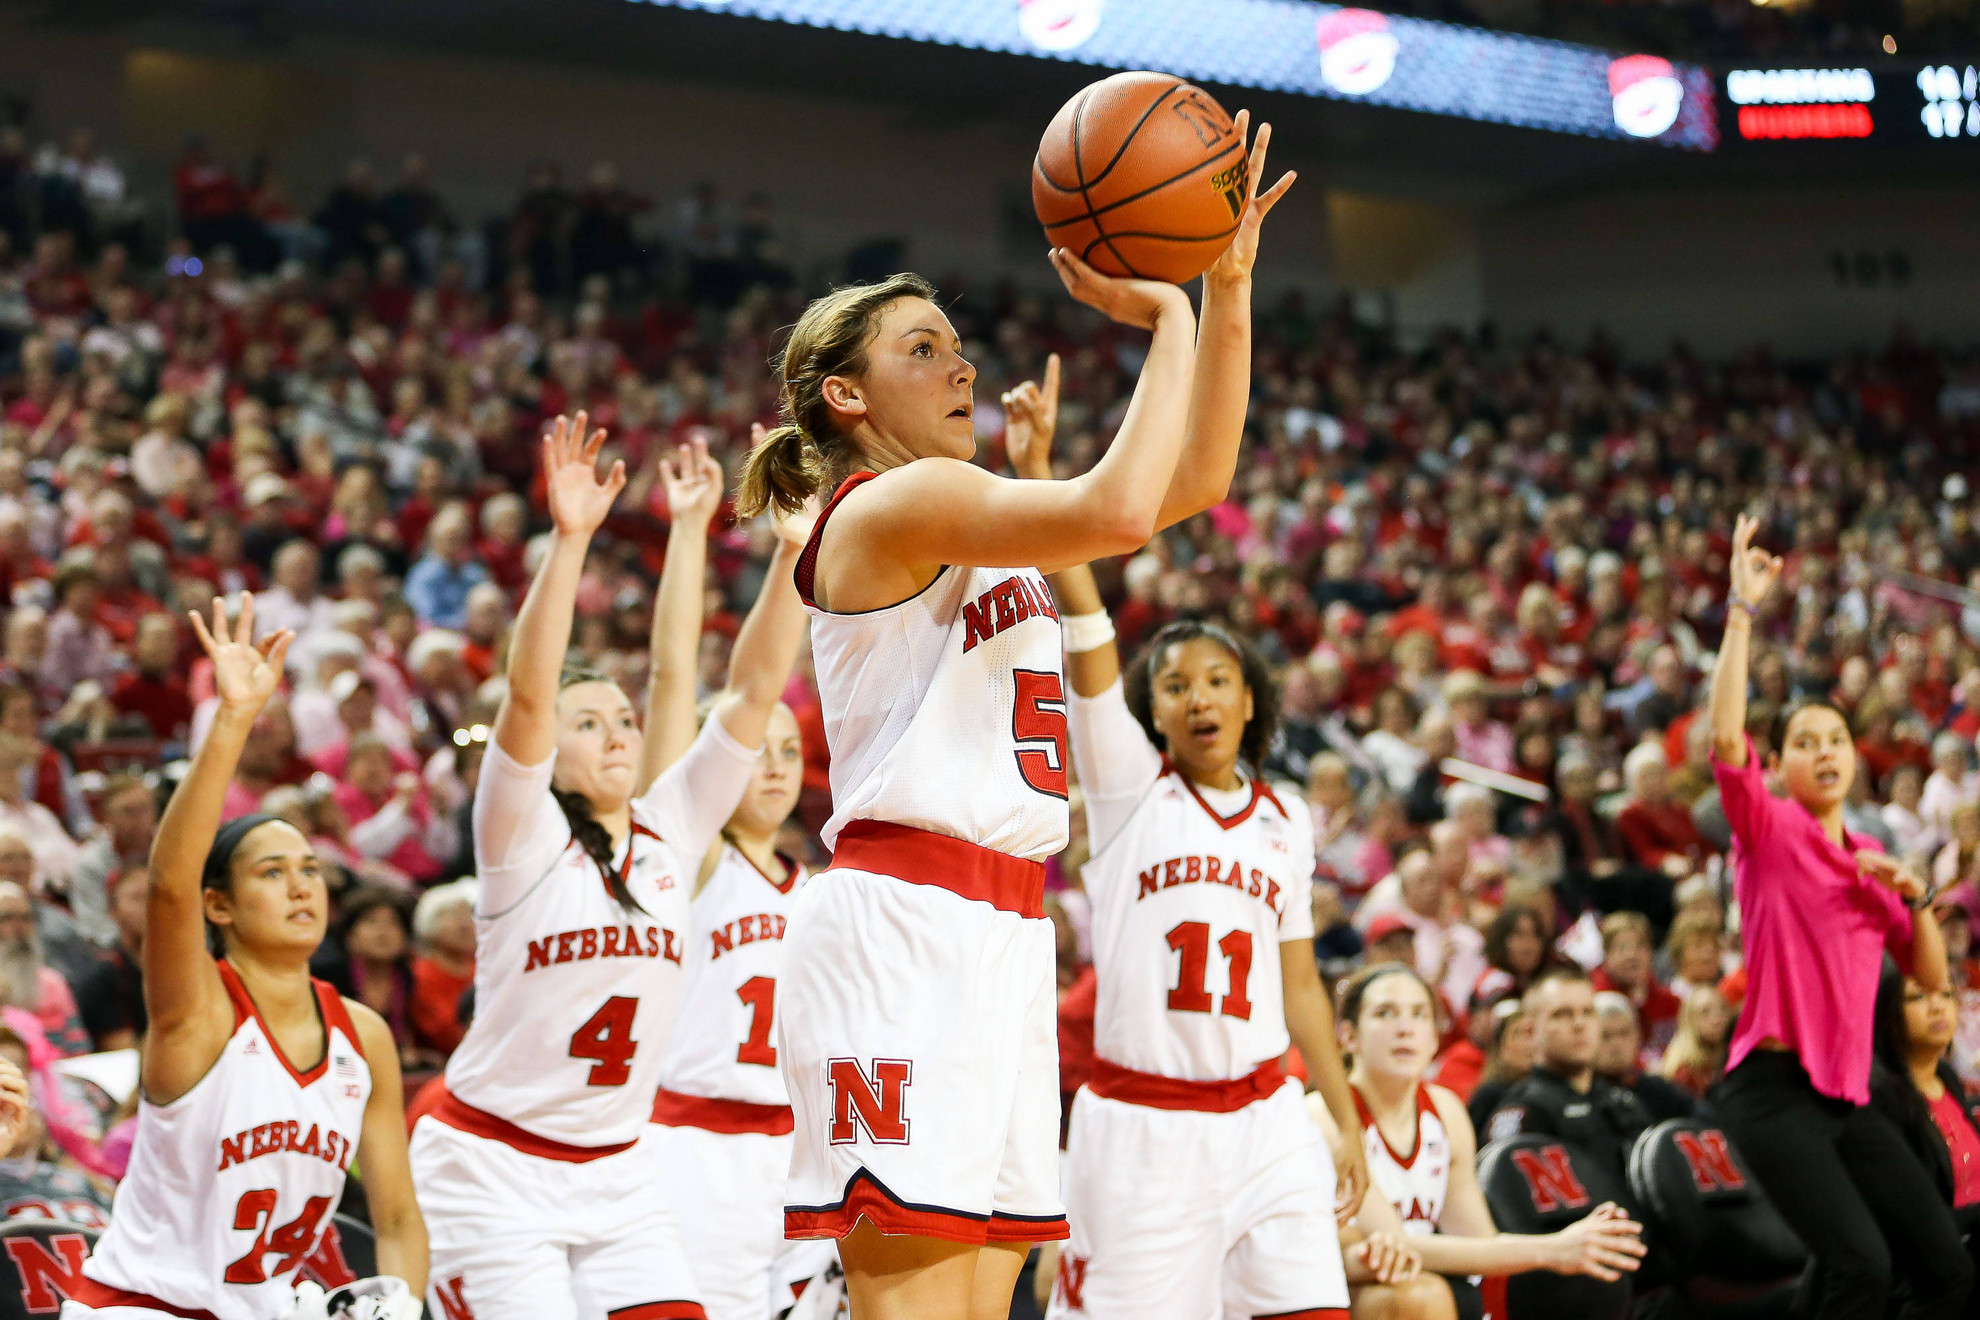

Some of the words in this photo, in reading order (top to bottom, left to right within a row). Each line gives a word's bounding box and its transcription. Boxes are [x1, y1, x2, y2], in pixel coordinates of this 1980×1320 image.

[1013, 668, 1068, 801] 5
[1165, 921, 1252, 1021] 11
[569, 995, 639, 1086] 4
[736, 976, 777, 1067] 1
[827, 1057, 912, 1146] N
[1511, 1145, 1589, 1212] N
[1673, 1131, 1747, 1193] N
[3, 1233, 91, 1314] N
[224, 1188, 333, 1284] 24
